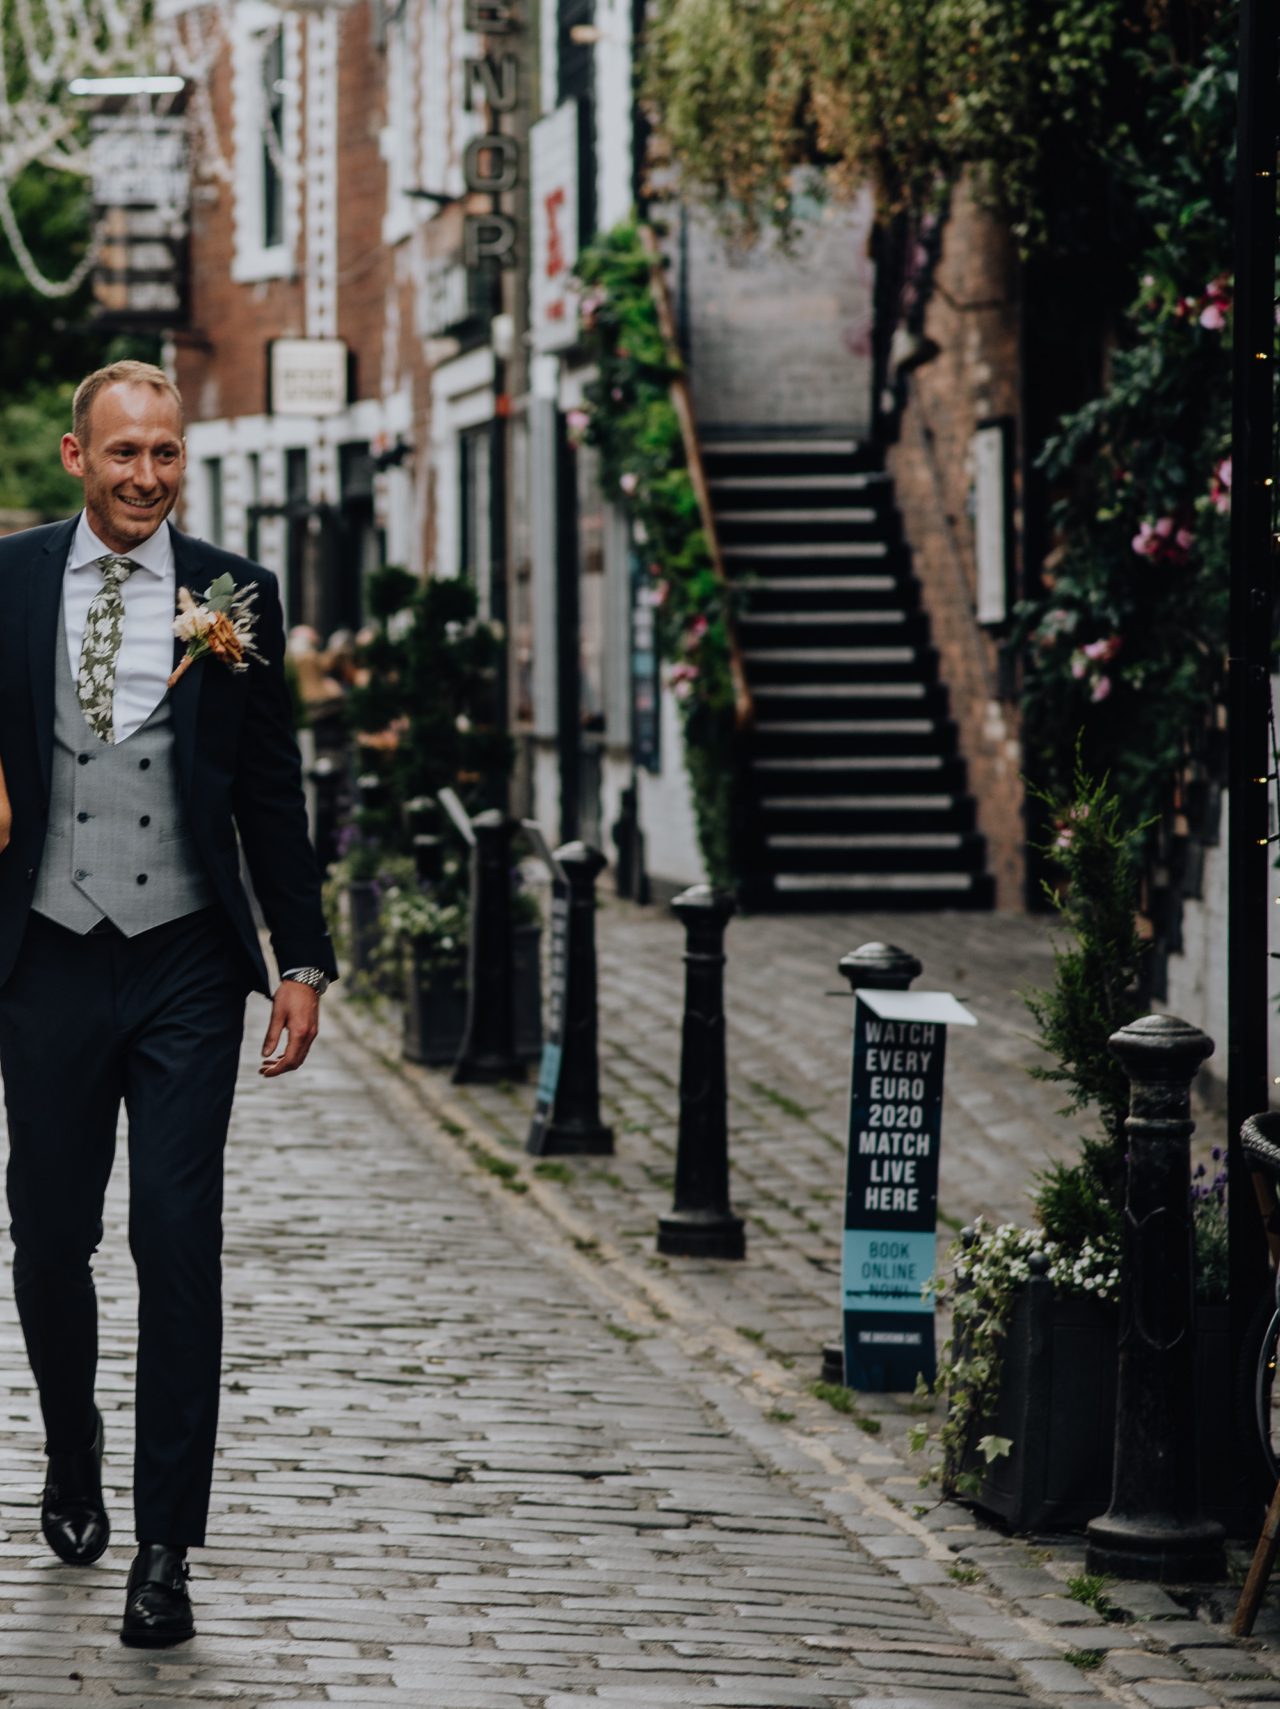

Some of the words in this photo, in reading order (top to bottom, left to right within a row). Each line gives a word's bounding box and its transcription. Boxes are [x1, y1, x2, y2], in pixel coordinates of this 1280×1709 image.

[865, 1021, 935, 1044] WATCH
[865, 1048, 932, 1073] EVERY
[870, 1076, 925, 1101] EURO
[868, 1103, 923, 1128] 2020
[858, 1131, 930, 1156] MATCH
[870, 1159, 916, 1184] LIVE
[865, 1186, 919, 1212] HERE
[869, 1241, 910, 1259] BOOK
[861, 1262, 917, 1280] ONLINE
